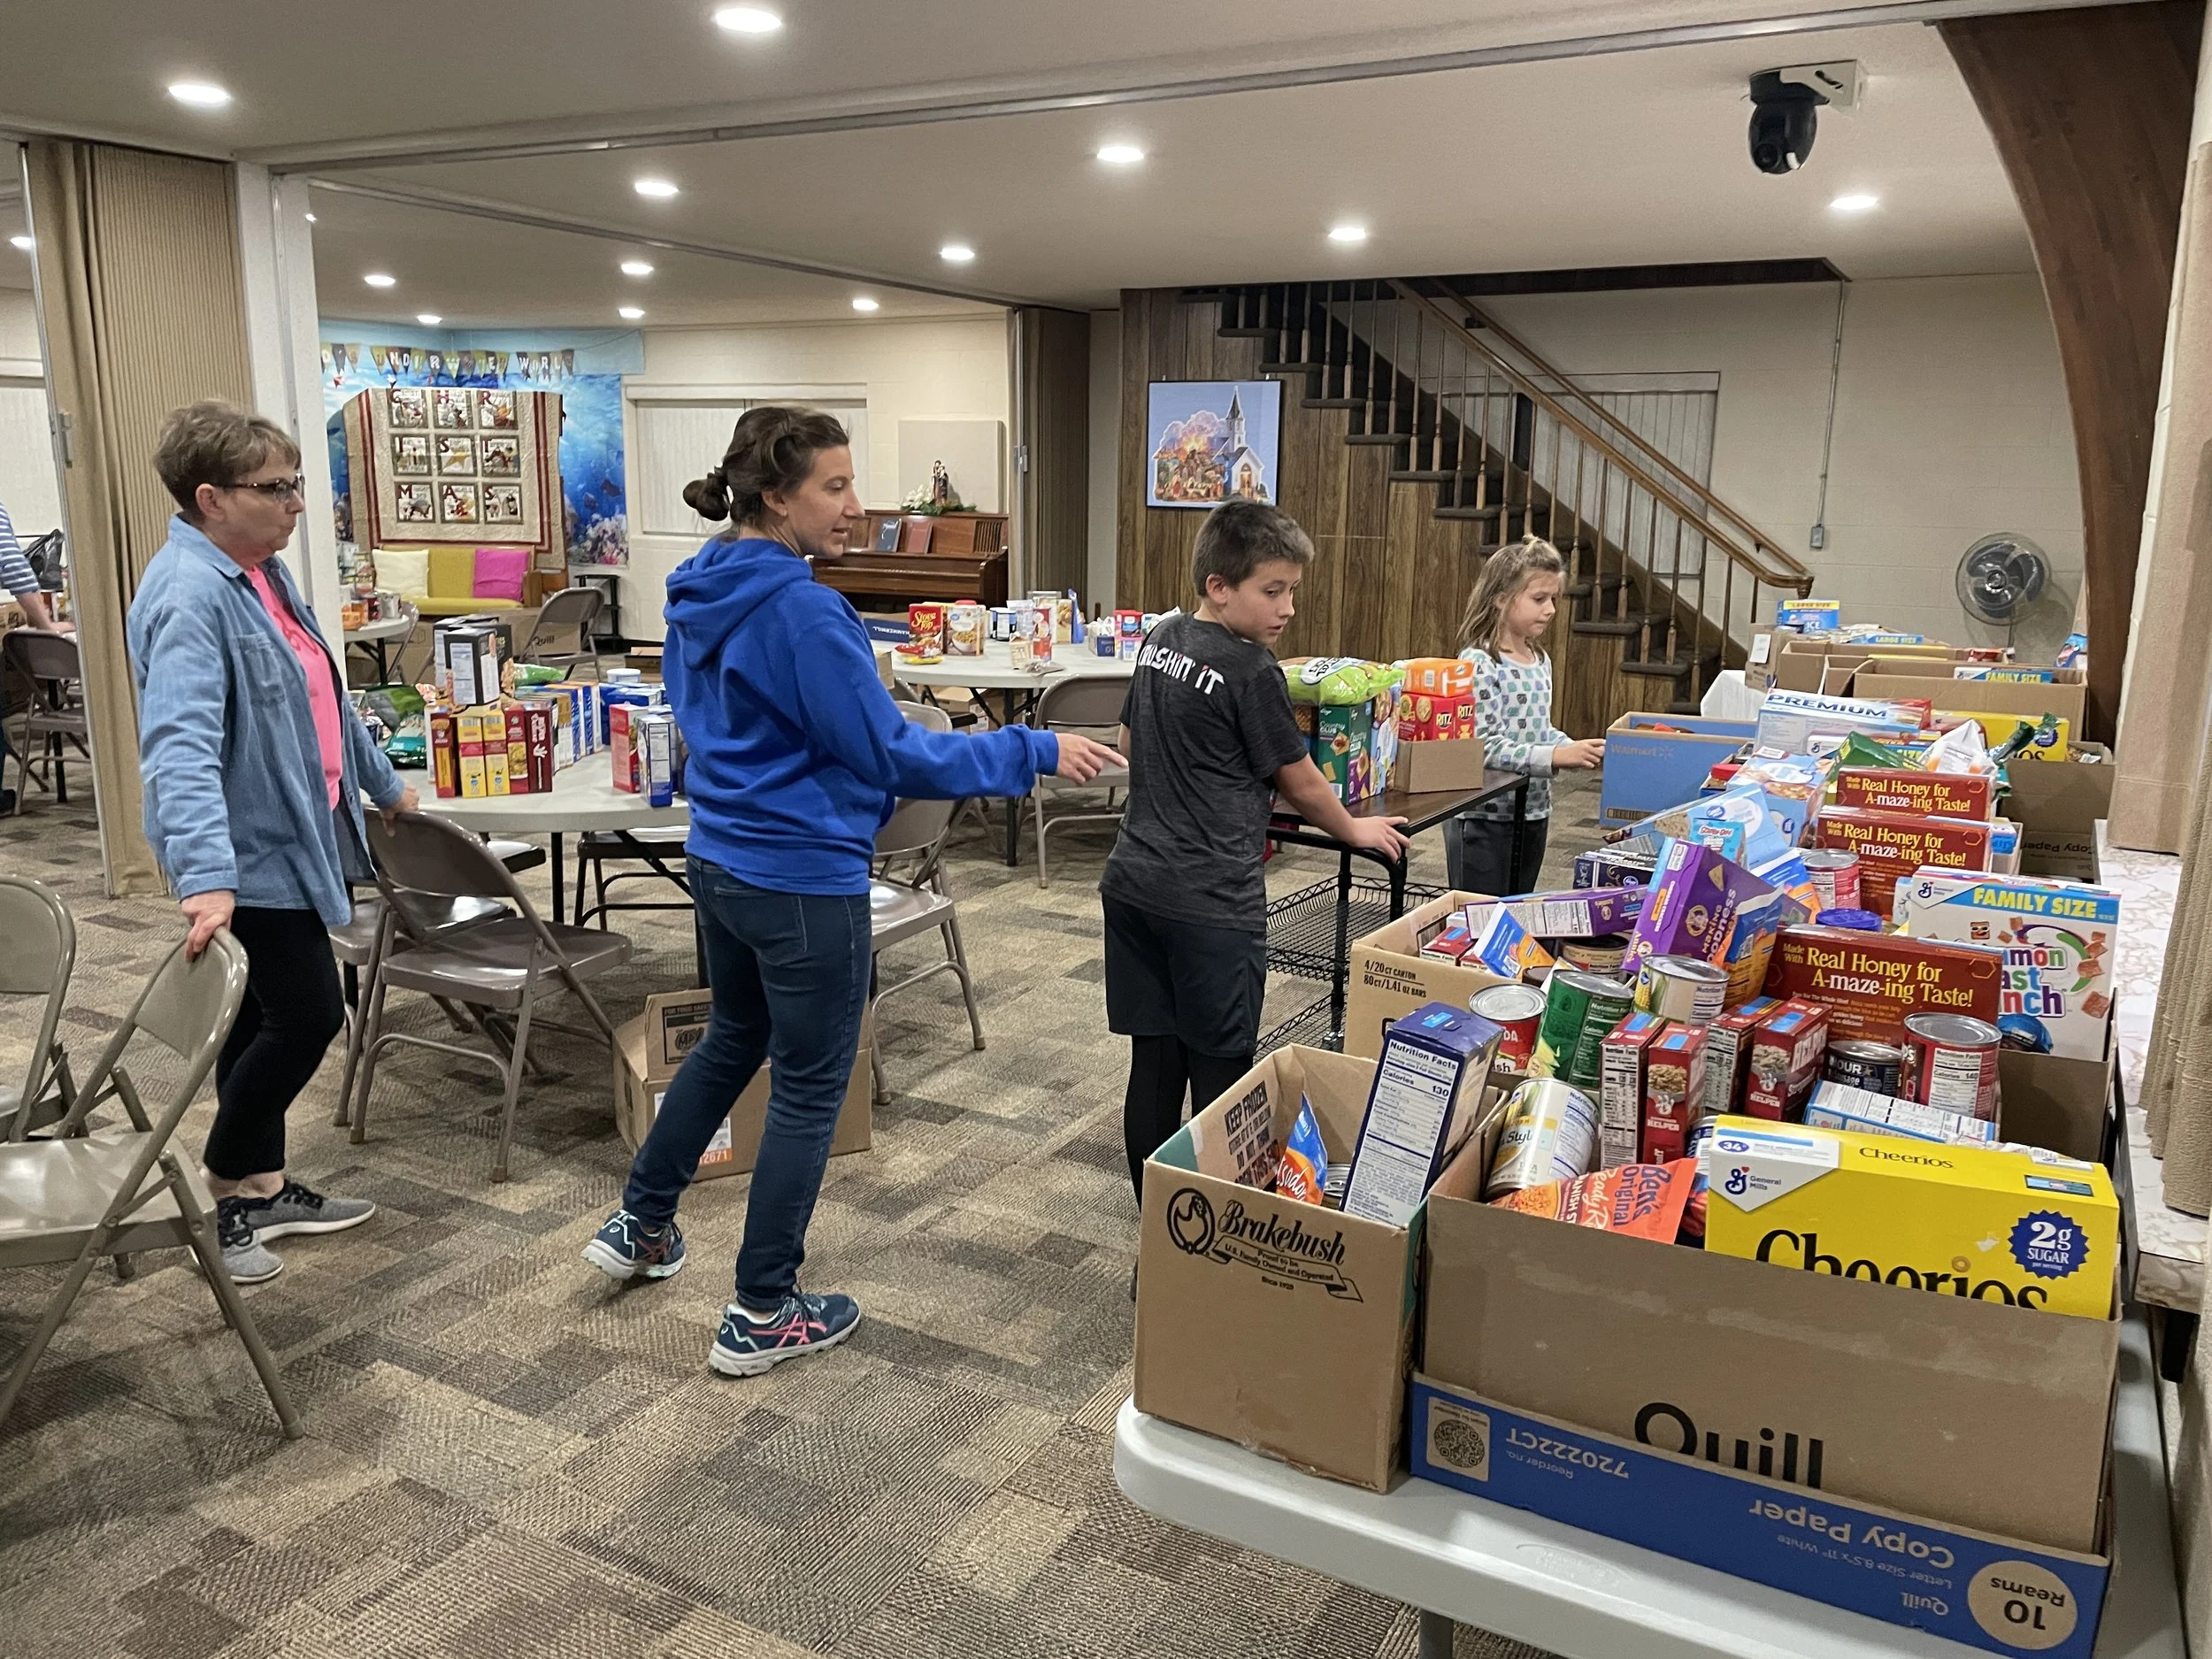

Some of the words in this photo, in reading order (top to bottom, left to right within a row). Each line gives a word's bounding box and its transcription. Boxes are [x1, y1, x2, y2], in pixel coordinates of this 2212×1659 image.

[911, 611, 937, 627] Stove
[919, 618, 933, 631] Top
[534, 636, 556, 646] Quill
[1876, 635, 1899, 644] LARGE
[1194, 664, 1225, 695] IT
[1985, 672, 2020, 682] FAMILY
[2021, 673, 2042, 683] SIZE
[1458, 704, 1474, 719] RITZ
[1767, 694, 1887, 718] PREMIUM
[1436, 713, 1453, 726] RITZ
[1862, 778, 1887, 792] Real
[1892, 781, 1931, 797] Honey
[1933, 783, 1951, 797] for
[1865, 793, 1933, 812] A-maze-ing
[1936, 797, 1971, 812] Taste!
[1844, 824, 1873, 840] Real
[1877, 827, 1922, 849] Honey
[1924, 833, 1944, 849] for
[1847, 840, 1923, 865] A-maze-ing
[1926, 849, 1967, 866] Taste!
[2020, 841, 2060, 853] Paper
[1972, 887, 2048, 912] FAMILY
[2051, 898, 2098, 919] SIZE
[1783, 943, 1805, 954] Made
[1784, 953, 1803, 964] With
[1807, 947, 1846, 970] Real
[1852, 953, 1912, 983] Honey
[1916, 961, 1944, 983] for
[1393, 968, 1417, 980] CARTON
[1812, 969, 1915, 1004] A-maze-ing
[1920, 983, 1974, 1007] Taste!
[1591, 1002, 1621, 1012] Nutrition
[1504, 1026, 1518, 1042] DA
[1390, 1041, 1430, 1061] Nutrition
[1432, 1056, 1456, 1070] Facts
[1936, 1048, 1964, 1059] Nutrition
[1383, 1069, 1415, 1086] Calories
[1432, 1085, 1449, 1097] 130
[1841, 1074, 1861, 1086] sage
[1933, 1070, 1961, 1079] Calories
[1224, 1102, 1242, 1138] KEEP
[1242, 1079, 1268, 1122] FROZEN
[1750, 1093, 1781, 1108] HELPER
[1647, 1119, 1680, 1132] HELPER
[1507, 1129, 1535, 1145] Styl
[1860, 1146, 1955, 1170] Cheerios
[1749, 1175, 1782, 1187] General
[1613, 1165, 1640, 1226] Original
[1632, 1164, 1671, 1222] Ben's
[1217, 1199, 1346, 1266] Brakebush
[2029, 1220, 2073, 1251] 2g
[1225, 1243, 1239, 1256] U.S.
[1240, 1250, 1261, 1267] Family
[1262, 1260, 1286, 1273] Owned
[1301, 1270, 1334, 1281] Operated
[1257, 1249, 1279, 1263] Proud
[1289, 1257, 1299, 1267] be
[2027, 1248, 2070, 1264] SUGAR
[2042, 1263, 2062, 1271] serving
[1505, 1427, 1629, 1479] 720222CT
[1506, 1450, 1524, 1462] no.
[1525, 1457, 1573, 1479] Reorder
[1750, 1496, 1852, 1544] Paper
[1776, 1535, 1818, 1554] White
[1862, 1525, 1955, 1570] Copy
[1877, 1562, 1905, 1578] Size
[1909, 1571, 1953, 1590] Letter
[1990, 1575, 2066, 1609] Reams
[1900, 1592, 1949, 1617] Quill
[2003, 1596, 2047, 1632] 10
